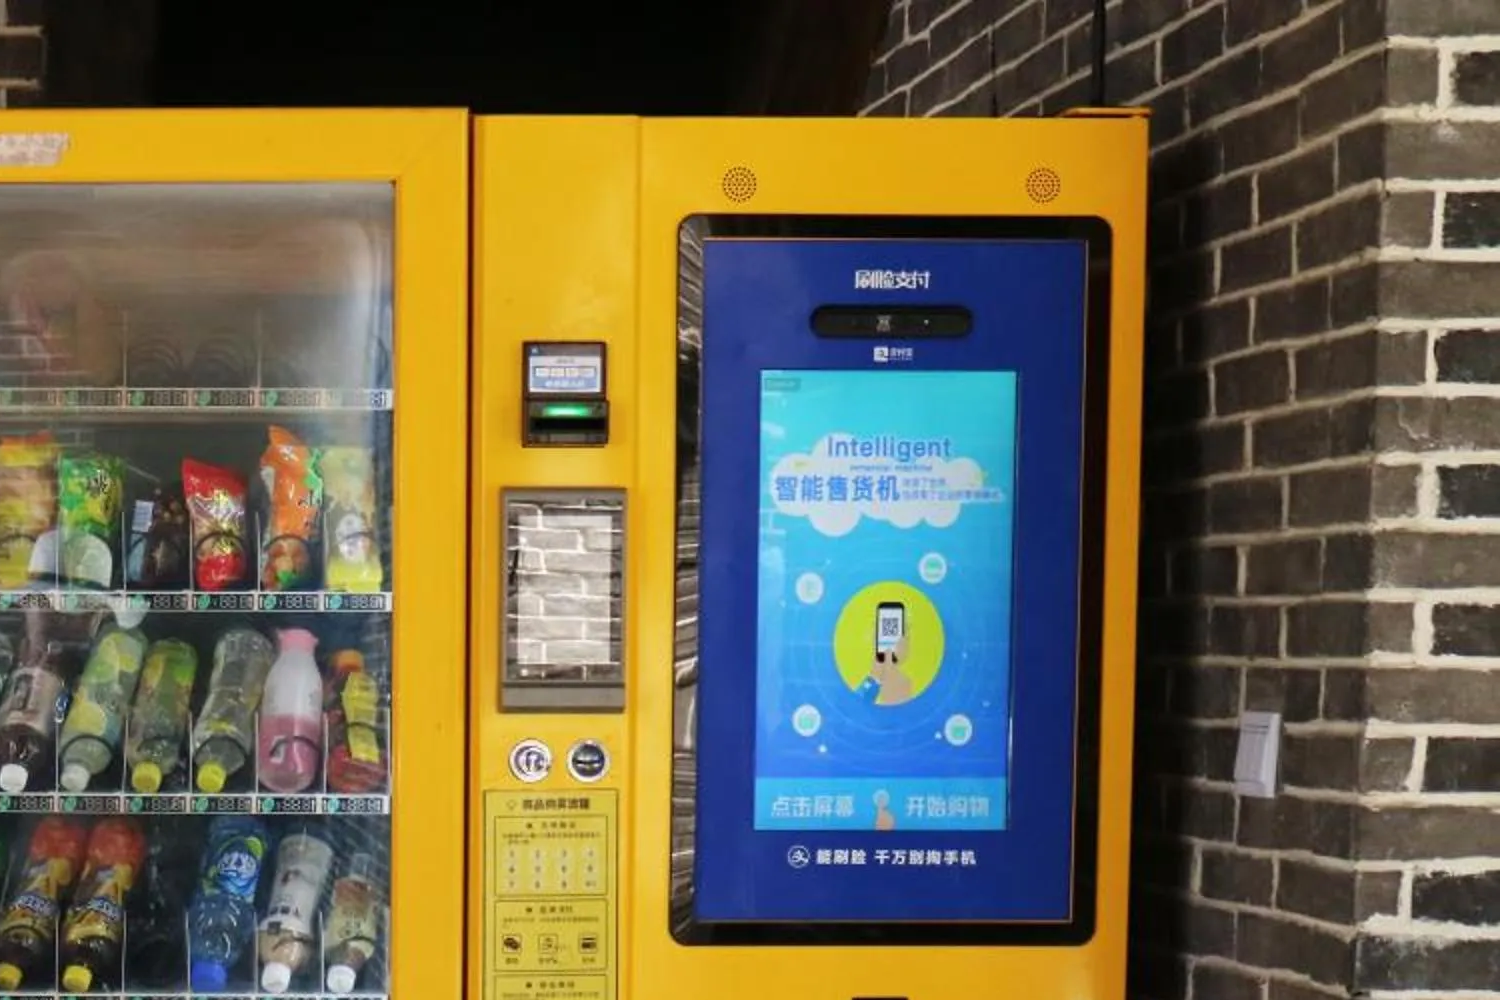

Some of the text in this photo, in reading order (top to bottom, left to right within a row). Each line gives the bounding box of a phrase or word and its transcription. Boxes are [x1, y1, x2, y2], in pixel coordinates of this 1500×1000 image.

[827, 435, 952, 463] Intelligent
[774, 474, 901, 502] 智能售货机
[771, 795, 990, 818] 点击屏幕 开始购物
